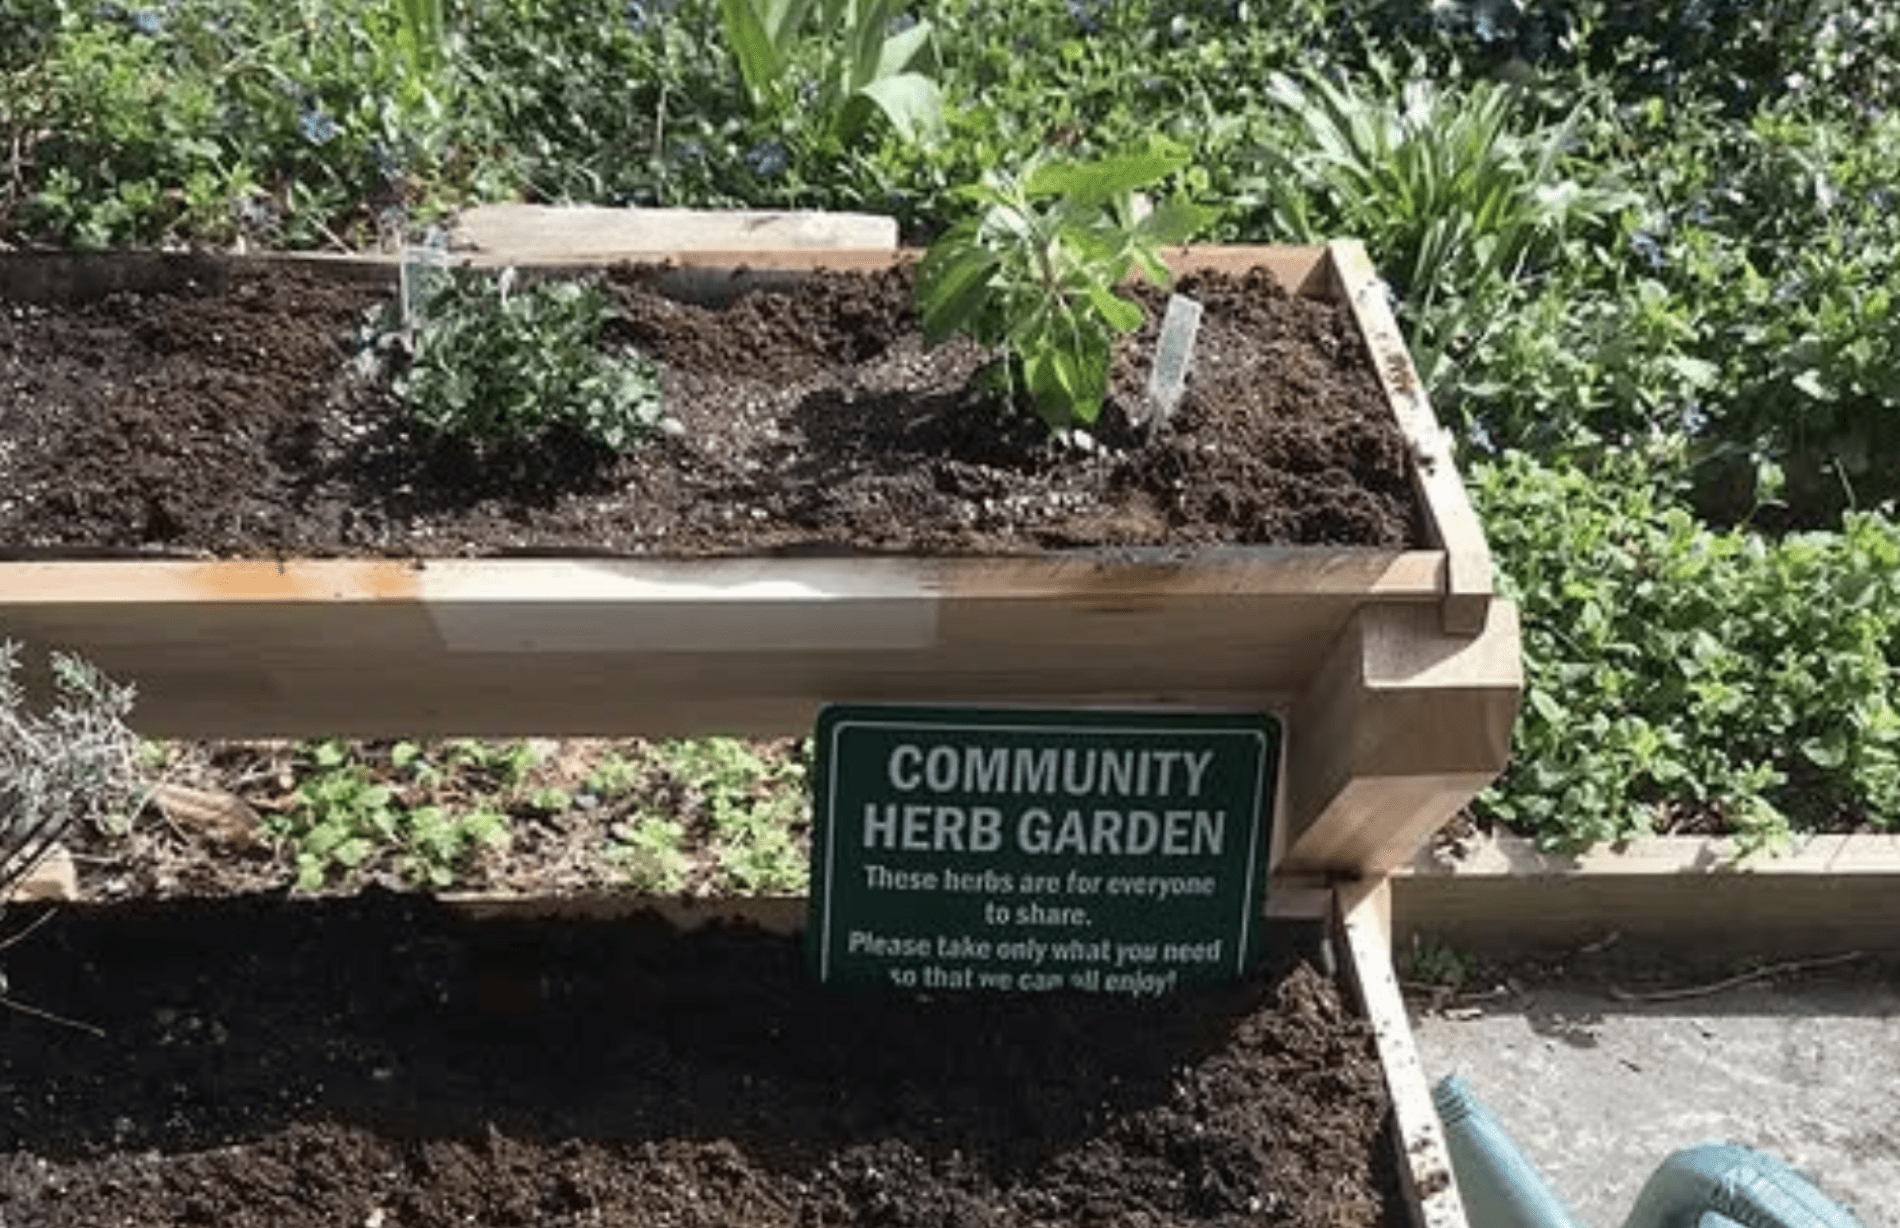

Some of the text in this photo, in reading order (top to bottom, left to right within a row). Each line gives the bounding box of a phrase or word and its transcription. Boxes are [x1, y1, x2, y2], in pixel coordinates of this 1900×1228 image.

[888, 743, 1215, 797] COMMUNITY
[862, 803, 1226, 856] HERB GARDEN
[864, 864, 1216, 900] These herbs are for everyone
[984, 901, 1092, 926] to share.
[848, 930, 1223, 968] Please take only what you need
[889, 965, 1178, 999] so that we can all enjoy!
